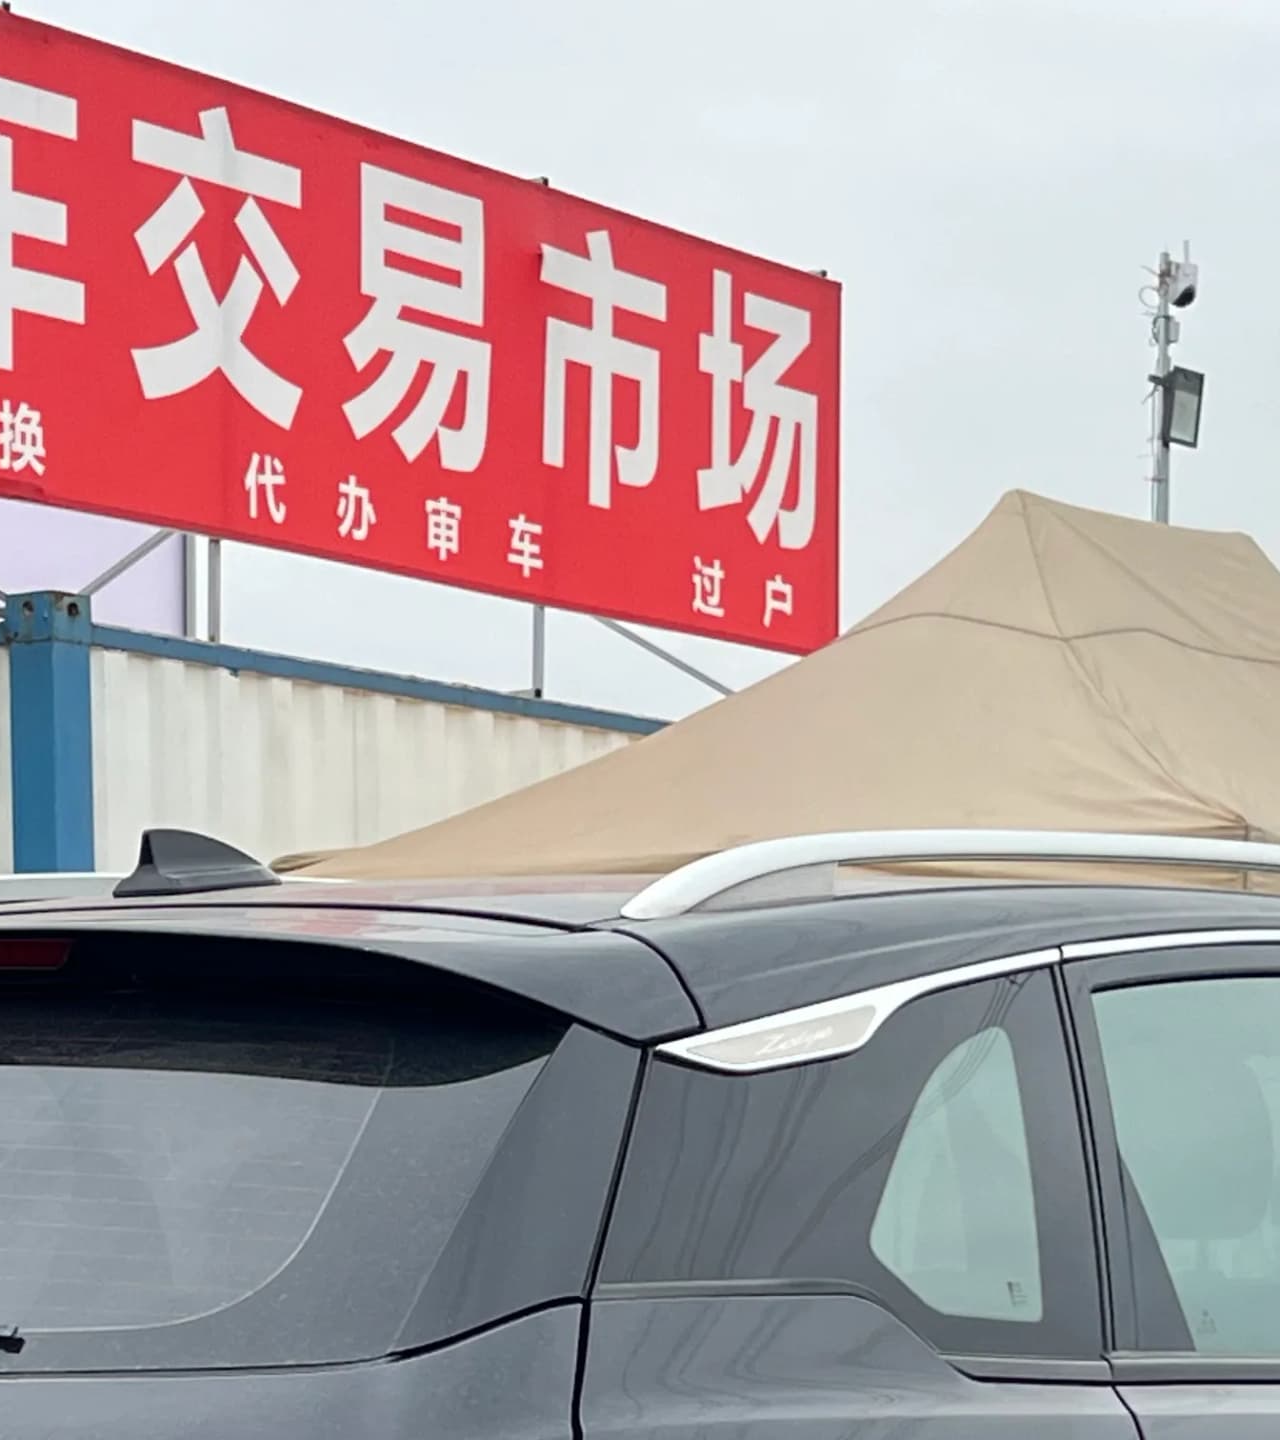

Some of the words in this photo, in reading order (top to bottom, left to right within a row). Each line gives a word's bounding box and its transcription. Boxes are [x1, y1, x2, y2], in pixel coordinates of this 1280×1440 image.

[244, 452, 545, 579] 代办审车
[692, 556, 793, 628] 过户
